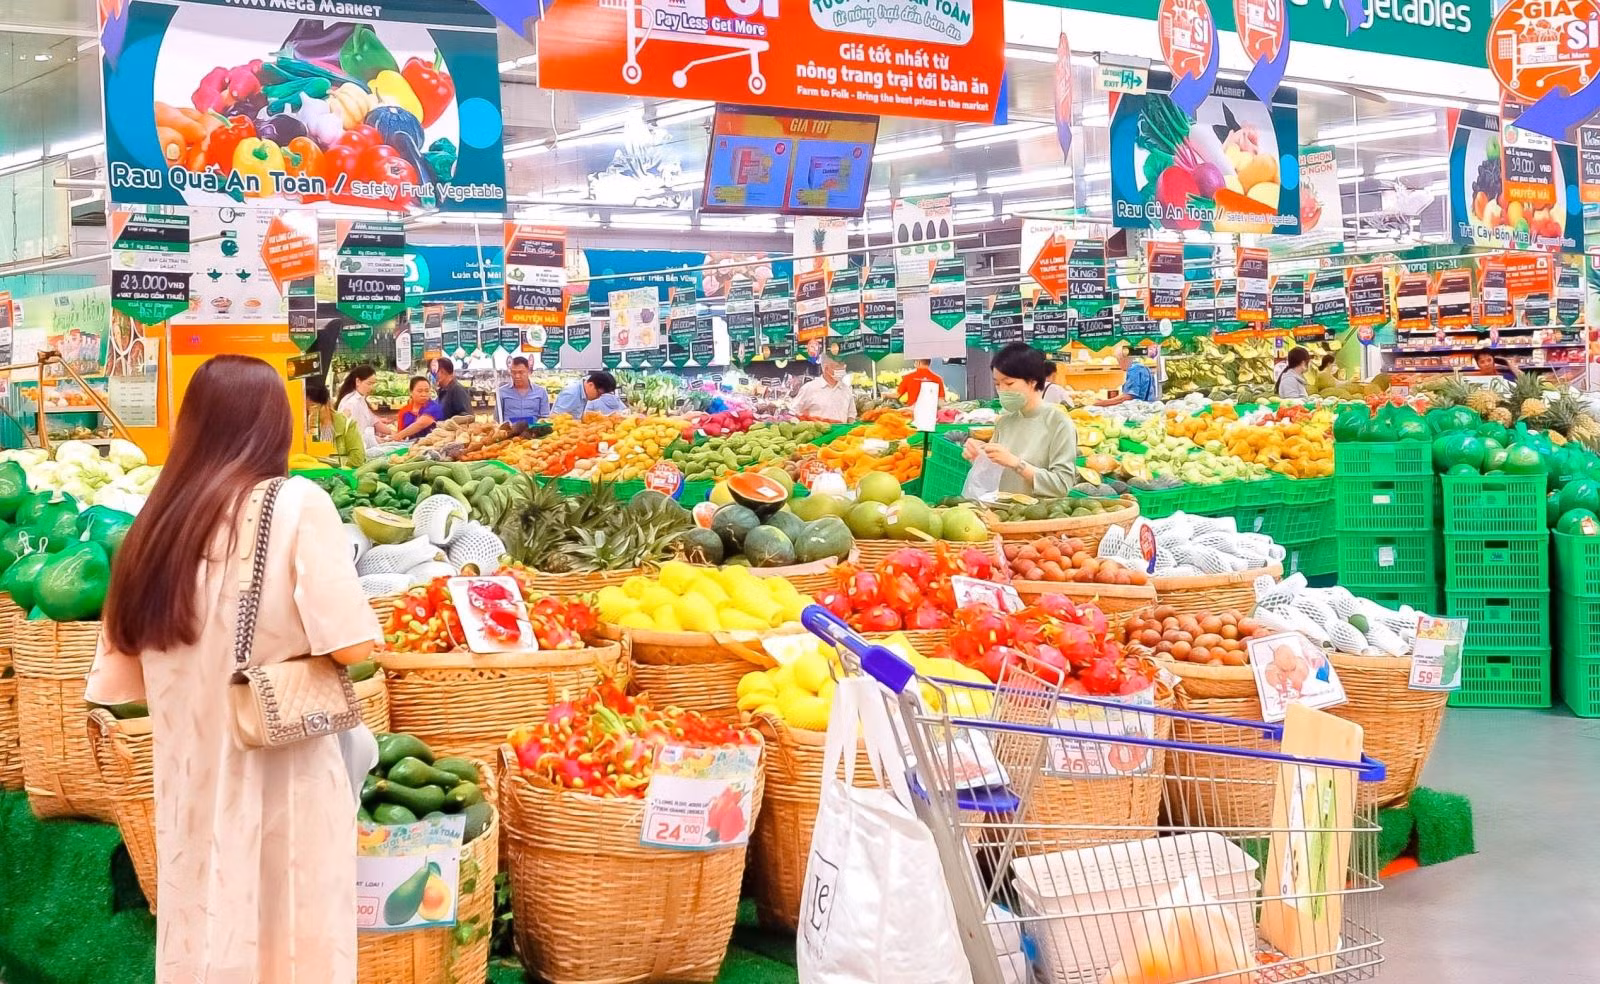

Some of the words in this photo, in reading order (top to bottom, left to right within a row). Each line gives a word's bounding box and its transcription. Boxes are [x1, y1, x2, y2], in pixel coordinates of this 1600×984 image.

[319, 2, 382, 17] Market
[848, 5, 876, 28] nông
[656, 9, 680, 31] Pay
[681, 12, 708, 31] Less
[711, 17, 733, 32] Get
[735, 19, 765, 36] More
[1567, 12, 1599, 50] SỈ
[840, 43, 864, 61] Giá
[868, 45, 892, 64] tốt
[895, 49, 930, 68] nhất
[933, 54, 950, 70] từ
[796, 61, 837, 85] nông
[841, 65, 883, 89] trang
[887, 70, 913, 92] trại
[916, 73, 937, 90] tới
[941, 74, 967, 93] bàn
[971, 77, 989, 95] ăn
[1104, 80, 1119, 88] EXIT
[797, 85, 819, 96] Farm
[821, 86, 830, 96] to
[831, 89, 849, 99] Folk
[857, 91, 879, 103] Bring
[880, 93, 894, 102] the
[895, 95, 913, 104] best
[914, 97, 937, 107] prices
[939, 98, 945, 107] in
[947, 99, 960, 108] the
[962, 101, 989, 111] market
[1215, 84, 1246, 98] Market
[111, 162, 163, 190] Rau
[169, 165, 220, 192] Quả
[225, 169, 261, 192] An
[269, 171, 327, 195] Toàn
[333, 173, 347, 196] /
[351, 181, 397, 200] Safety
[400, 183, 436, 198] Fruit
[437, 183, 504, 201] Vegetable
[1116, 200, 1142, 217] Rau
[1166, 205, 1183, 220] An
[121, 274, 168, 291] 23.000
[348, 278, 385, 293] 49.000
[1069, 282, 1096, 295] 14.500
[1418, 671, 1432, 684] 59
[656, 823, 681, 840] 24
[684, 824, 700, 834] 000
